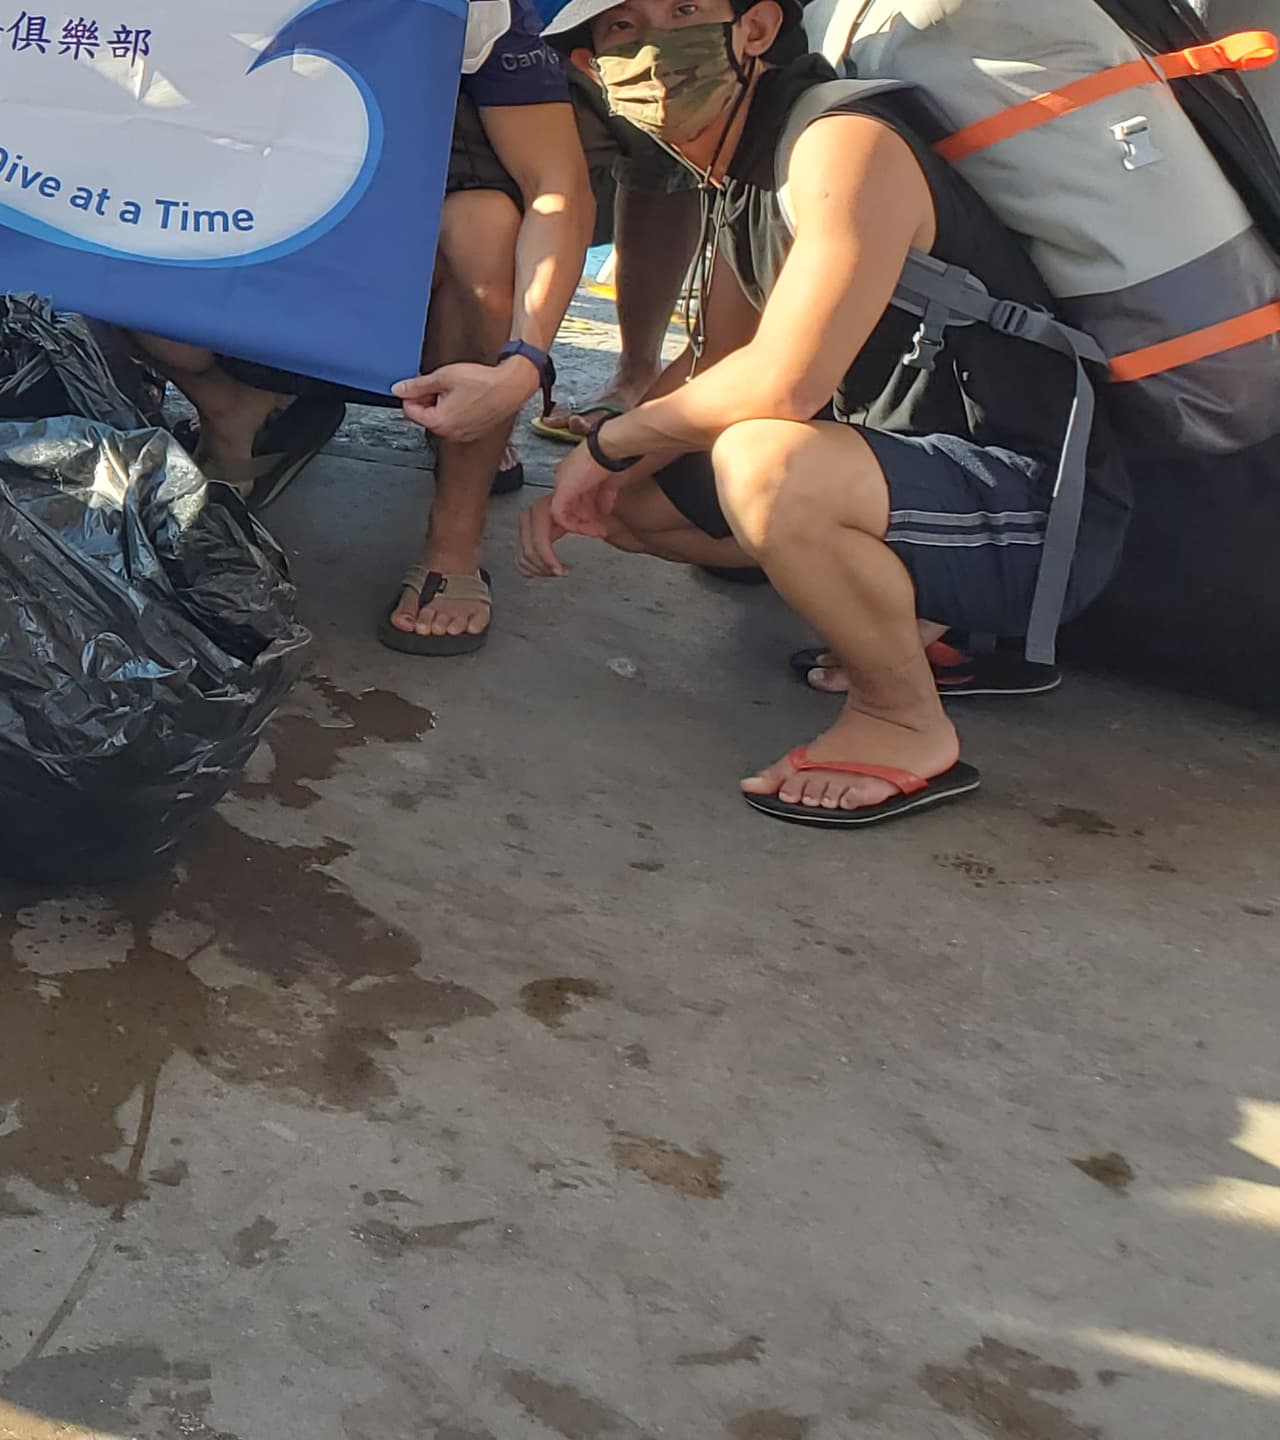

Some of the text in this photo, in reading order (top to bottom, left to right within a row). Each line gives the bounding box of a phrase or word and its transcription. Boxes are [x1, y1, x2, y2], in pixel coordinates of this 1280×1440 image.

[69, 186, 112, 218] at
[117, 200, 144, 226] a
[154, 198, 256, 234] Time
